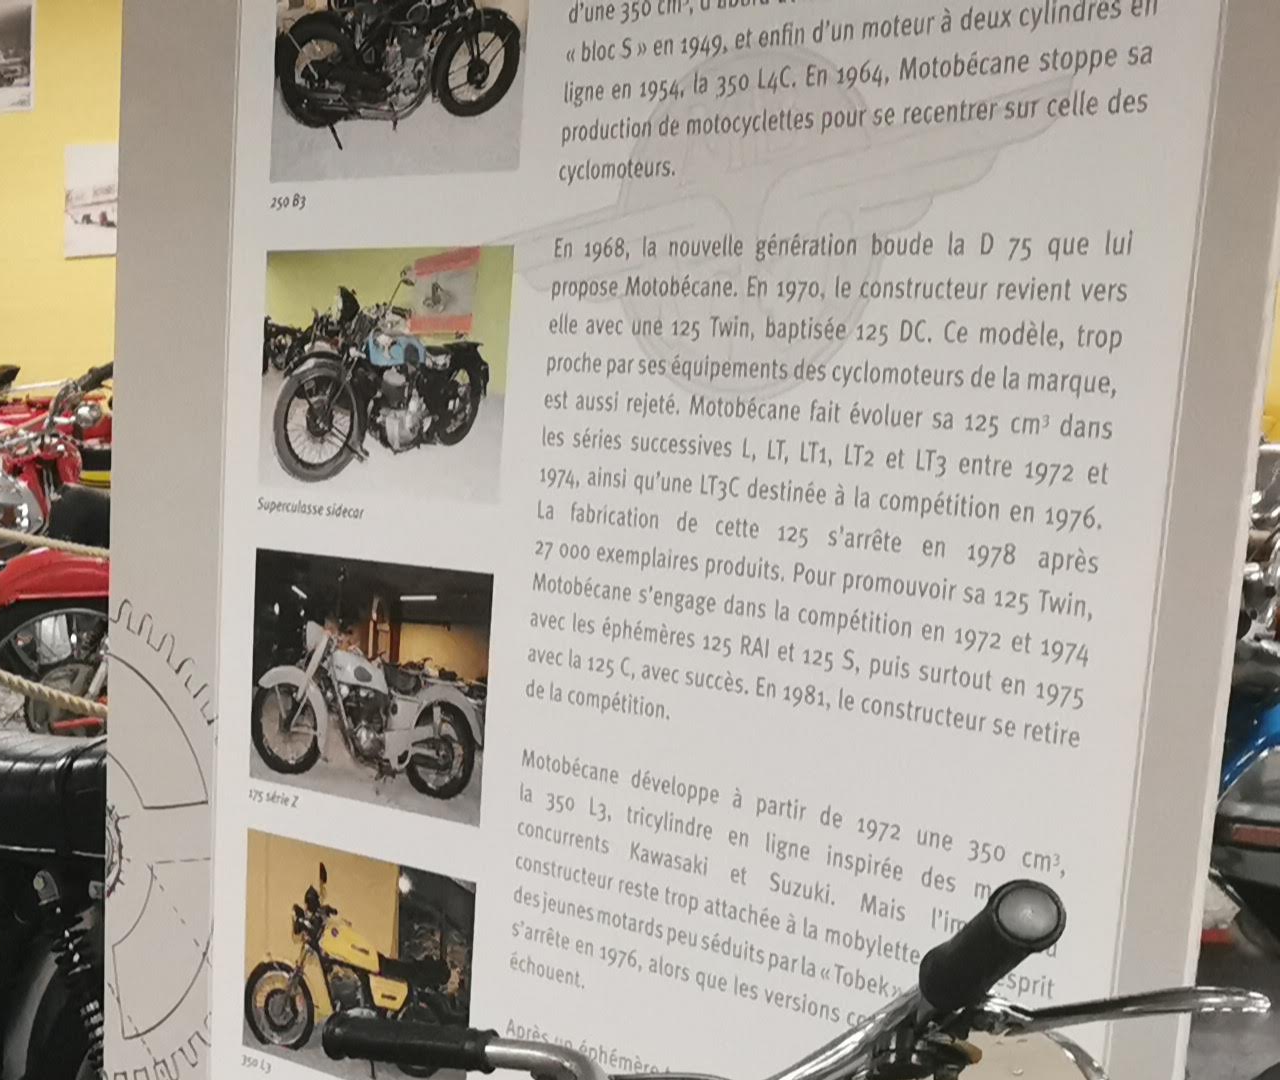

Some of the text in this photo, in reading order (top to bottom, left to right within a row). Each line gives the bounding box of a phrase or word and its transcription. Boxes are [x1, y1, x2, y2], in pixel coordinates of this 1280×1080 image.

[558, 157, 675, 186] cyclomoteurs.
[270, 192, 307, 212] 250 B3
[551, 273, 1127, 303] propose Motobécane. En 1970, le constructeur revient vers
[257, 496, 365, 520] Superculasse sidecar
[537, 499, 554, 520] La
[570, 500, 659, 530] fabrication
[676, 510, 698, 533] de
[715, 517, 759, 539] cette
[777, 525, 808, 549] 125
[921, 538, 946, 558] en
[967, 542, 1016, 568] 1978
[1037, 546, 1099, 576] après
[521, 748, 619, 785] Motobécane
[630, 768, 720, 806] développe
[731, 786, 742, 809] à
[755, 797, 807, 821] partir
[819, 804, 843, 829] de
[857, 817, 901, 843] 1972
[916, 828, 953, 852] une
[967, 839, 1006, 864] 350
[516, 821, 610, 854] concurrents
[629, 840, 708, 877] Kawasaki
[729, 866, 747, 886] et
[769, 871, 835, 906] Suzuki.
[859, 892, 906, 922] Mais
[509, 950, 585, 990] échouent.
